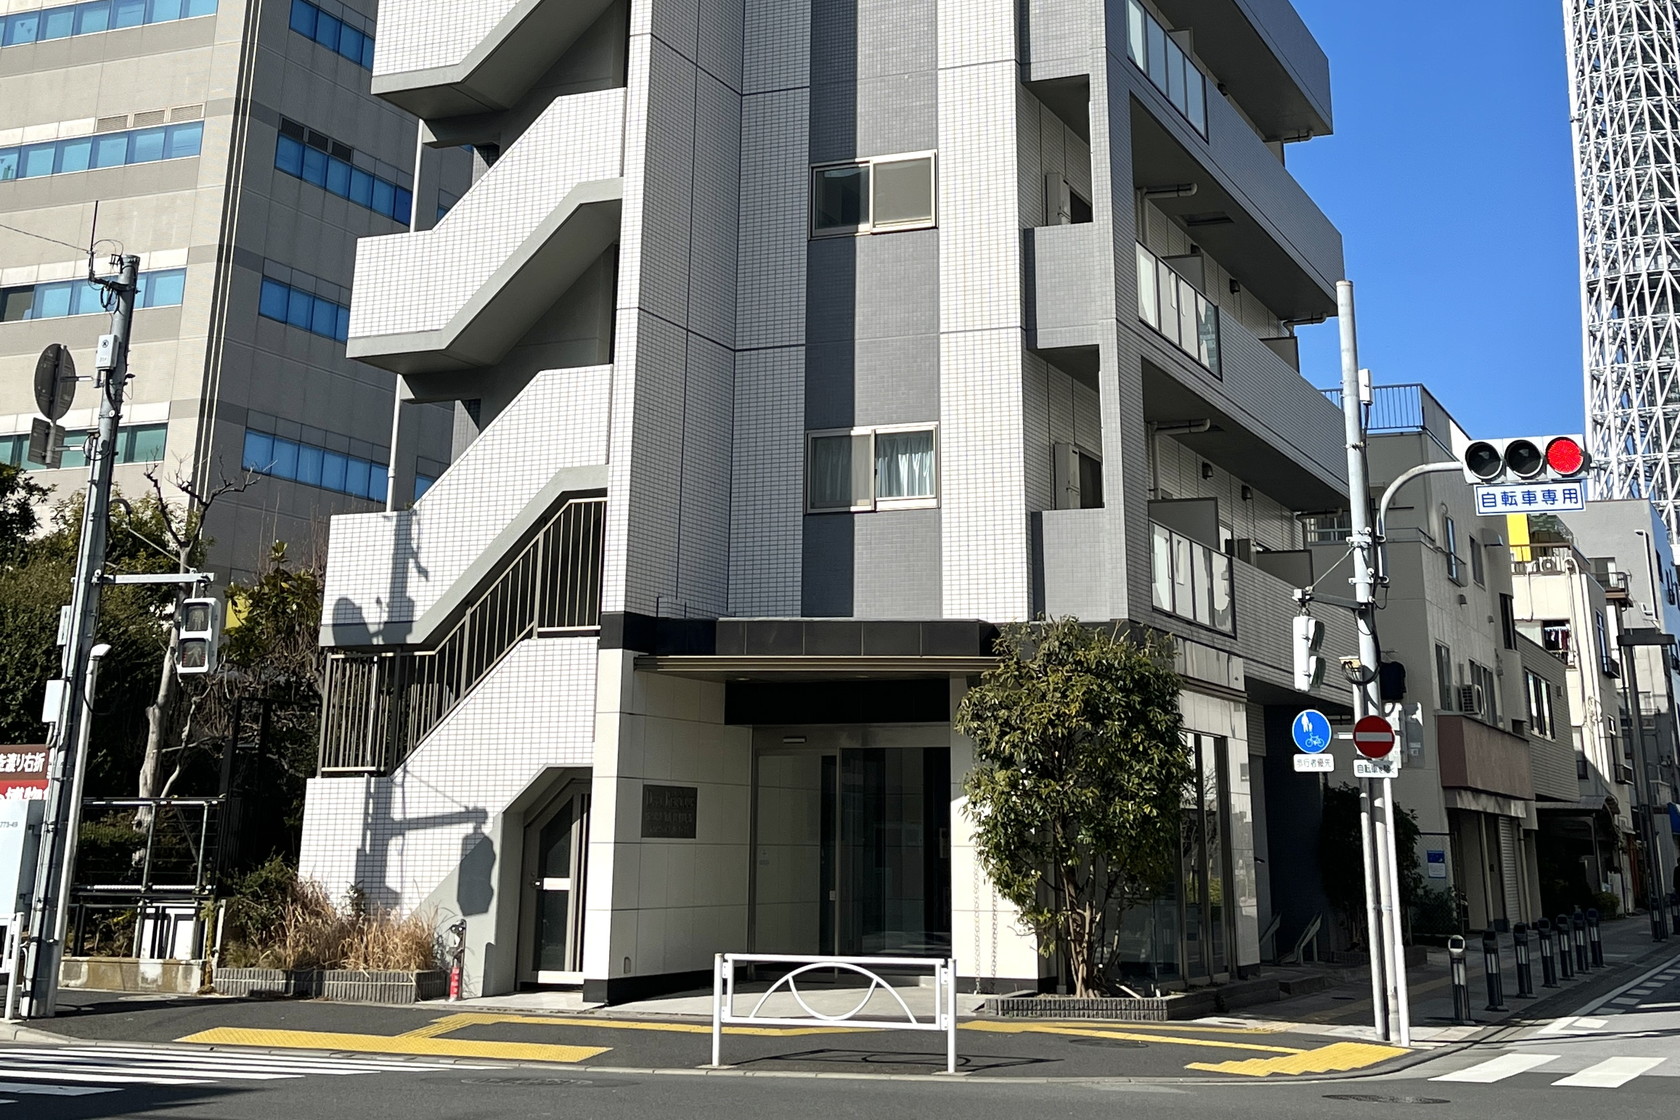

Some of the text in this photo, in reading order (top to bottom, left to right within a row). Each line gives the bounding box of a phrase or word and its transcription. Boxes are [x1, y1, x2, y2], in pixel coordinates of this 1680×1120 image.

[1481, 488, 1579, 508] 自転車専用
